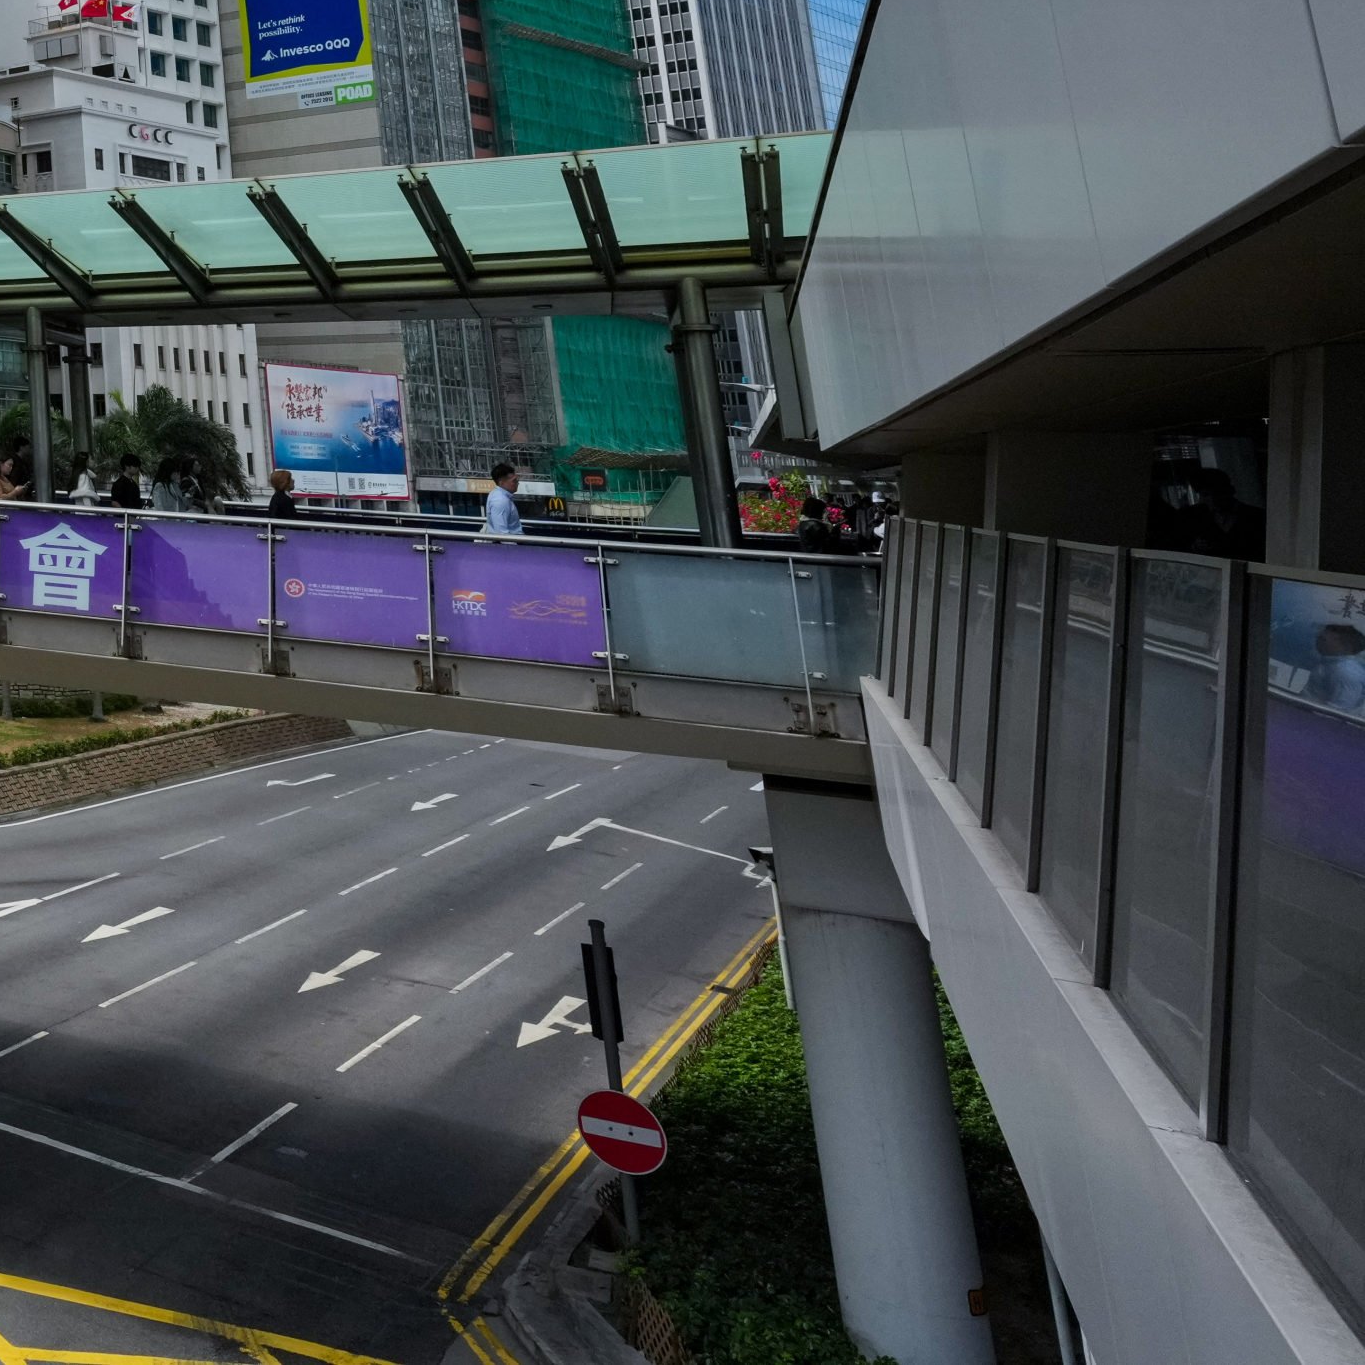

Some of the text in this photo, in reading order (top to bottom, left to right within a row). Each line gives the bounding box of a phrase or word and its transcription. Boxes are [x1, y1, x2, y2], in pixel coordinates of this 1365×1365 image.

[258, 14, 305, 30] Let's rethink
[259, 26, 303, 40] possibility.
[279, 37, 351, 58] Invesco QQQ
[337, 84, 373, 101] POAD
[128, 123, 174, 146] CGCC
[452, 600, 486, 612] HKTDC
